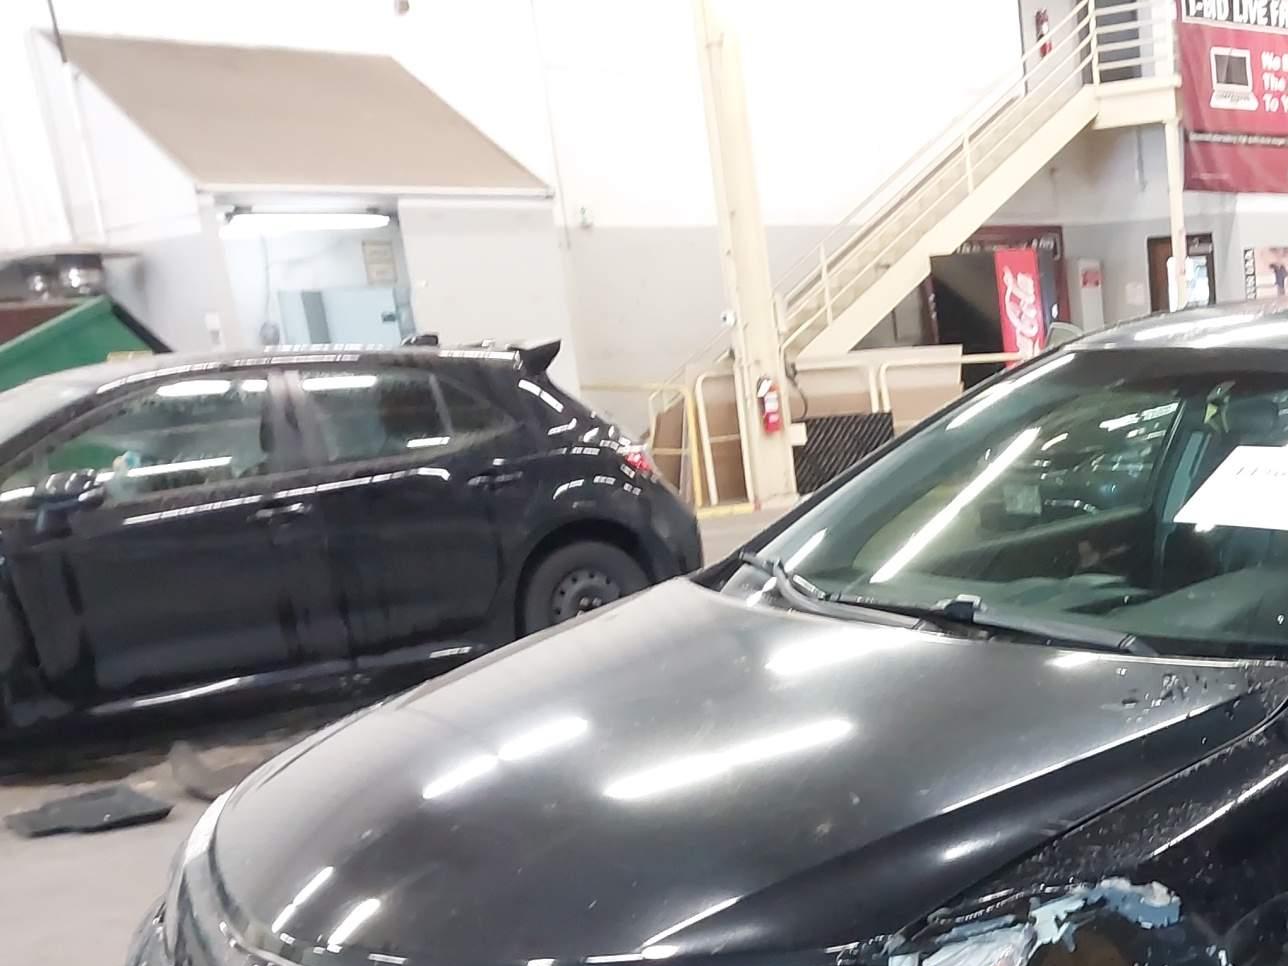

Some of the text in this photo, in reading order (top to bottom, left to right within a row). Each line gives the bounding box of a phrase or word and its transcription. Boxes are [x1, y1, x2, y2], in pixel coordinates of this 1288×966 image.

[1233, 0, 1268, 25] LIVE
[1261, 51, 1281, 72] We
[1262, 72, 1286, 92] The
[1263, 93, 1280, 113] To
